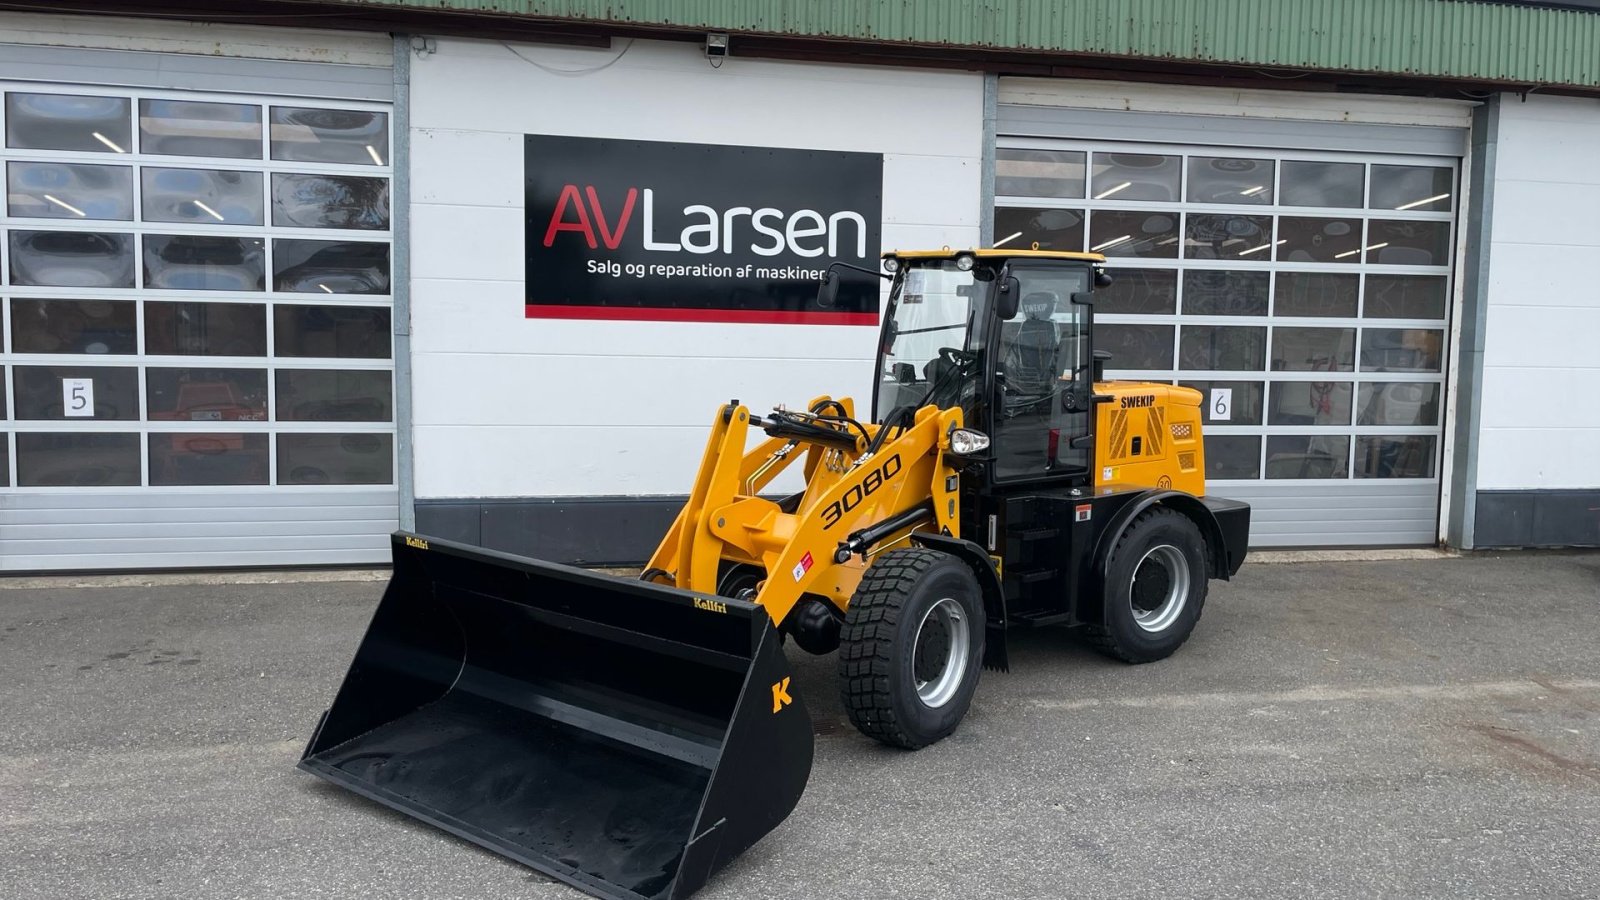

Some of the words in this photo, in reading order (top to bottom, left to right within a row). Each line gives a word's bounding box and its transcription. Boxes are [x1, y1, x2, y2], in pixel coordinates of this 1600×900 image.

[587, 260, 621, 277] Salg
[625, 263, 646, 278] og
[649, 263, 732, 279] reparation
[736, 264, 753, 278] af
[756, 265, 826, 280] maskiner
[72, 386, 87, 410] 5
[1121, 395, 1155, 408] SWEKIP
[1215, 395, 1227, 414] 6
[820, 453, 902, 530] 3080
[406, 536, 429, 550] Kellfri
[693, 597, 727, 614] Kellfri
[772, 676, 792, 714] K
